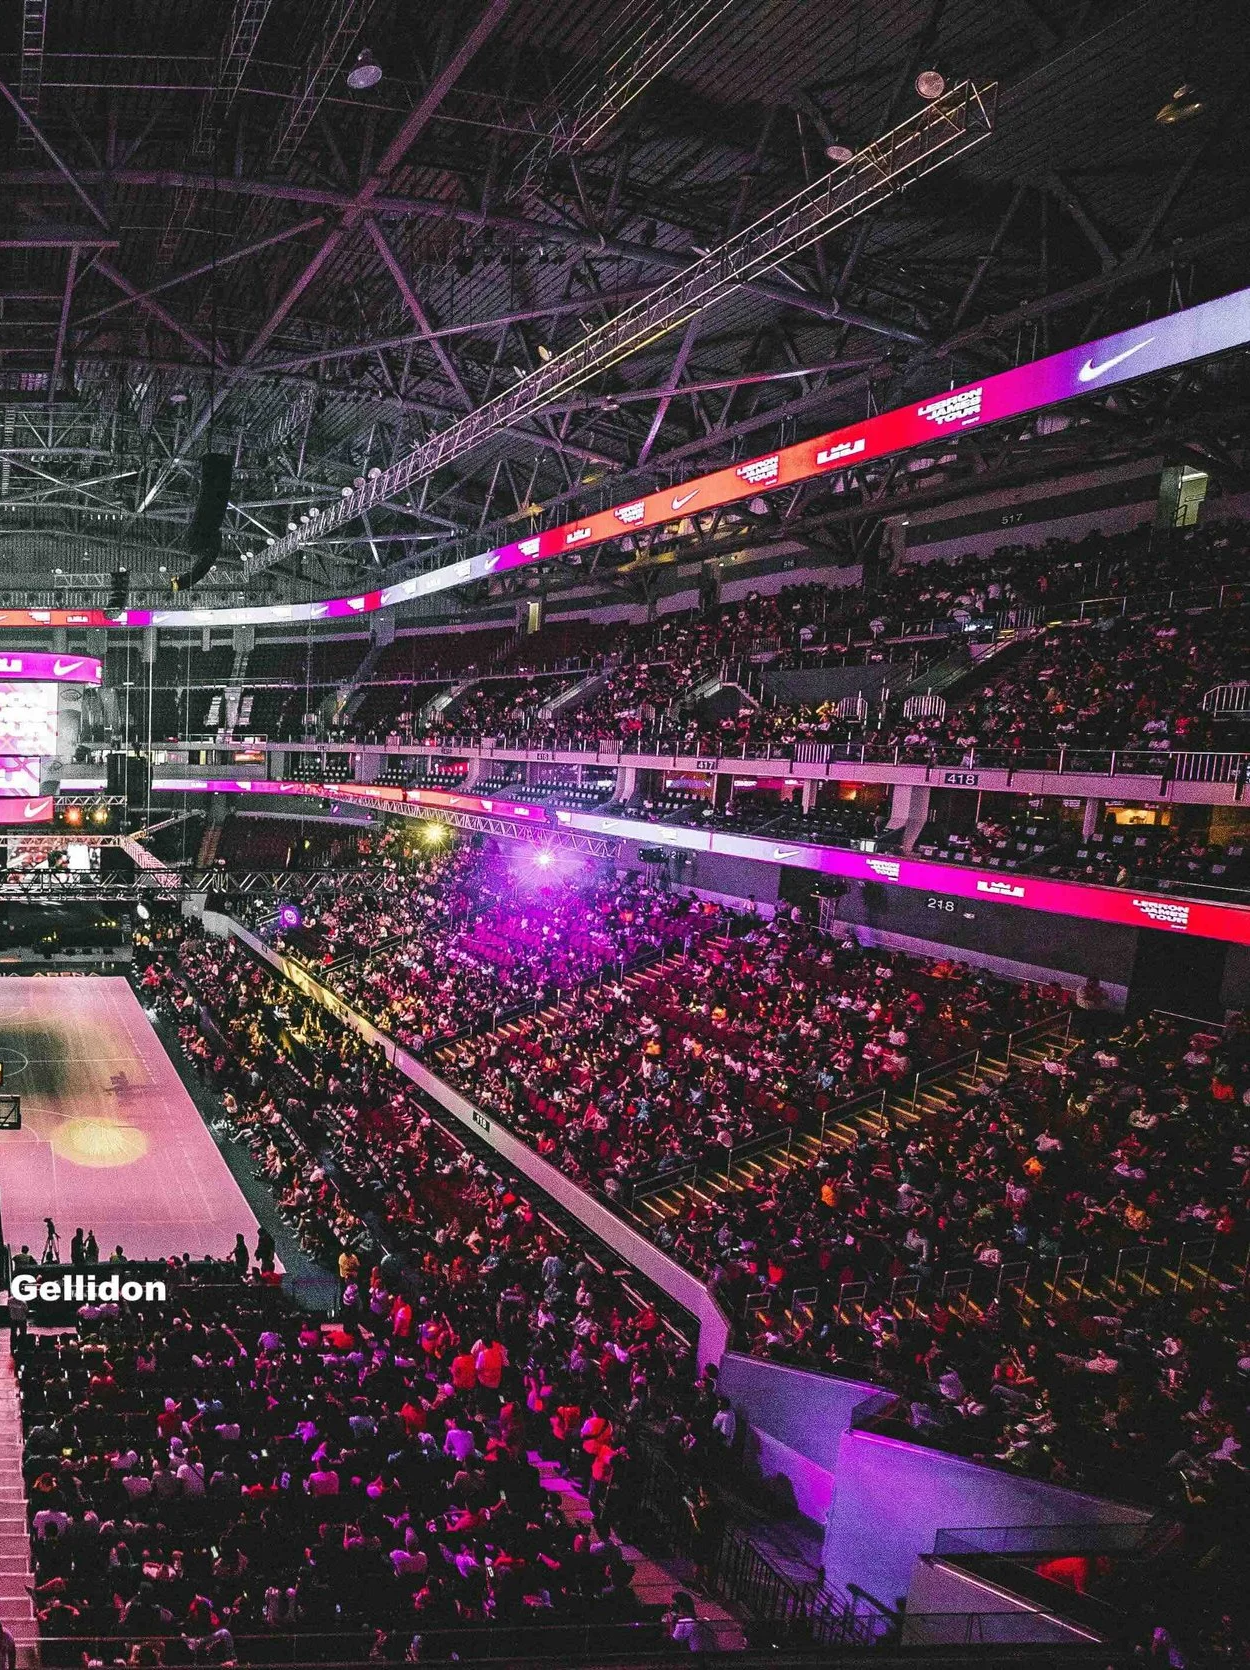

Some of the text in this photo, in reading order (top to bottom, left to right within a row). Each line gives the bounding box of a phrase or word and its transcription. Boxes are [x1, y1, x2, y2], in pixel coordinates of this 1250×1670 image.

[918, 387, 983, 416] LEBRON
[926, 396, 982, 420] JAMES
[934, 405, 981, 425] TOUR
[1001, 513, 1023, 525] 517
[698, 762, 714, 770] 417
[947, 774, 976, 785] 418
[928, 897, 955, 912] 218
